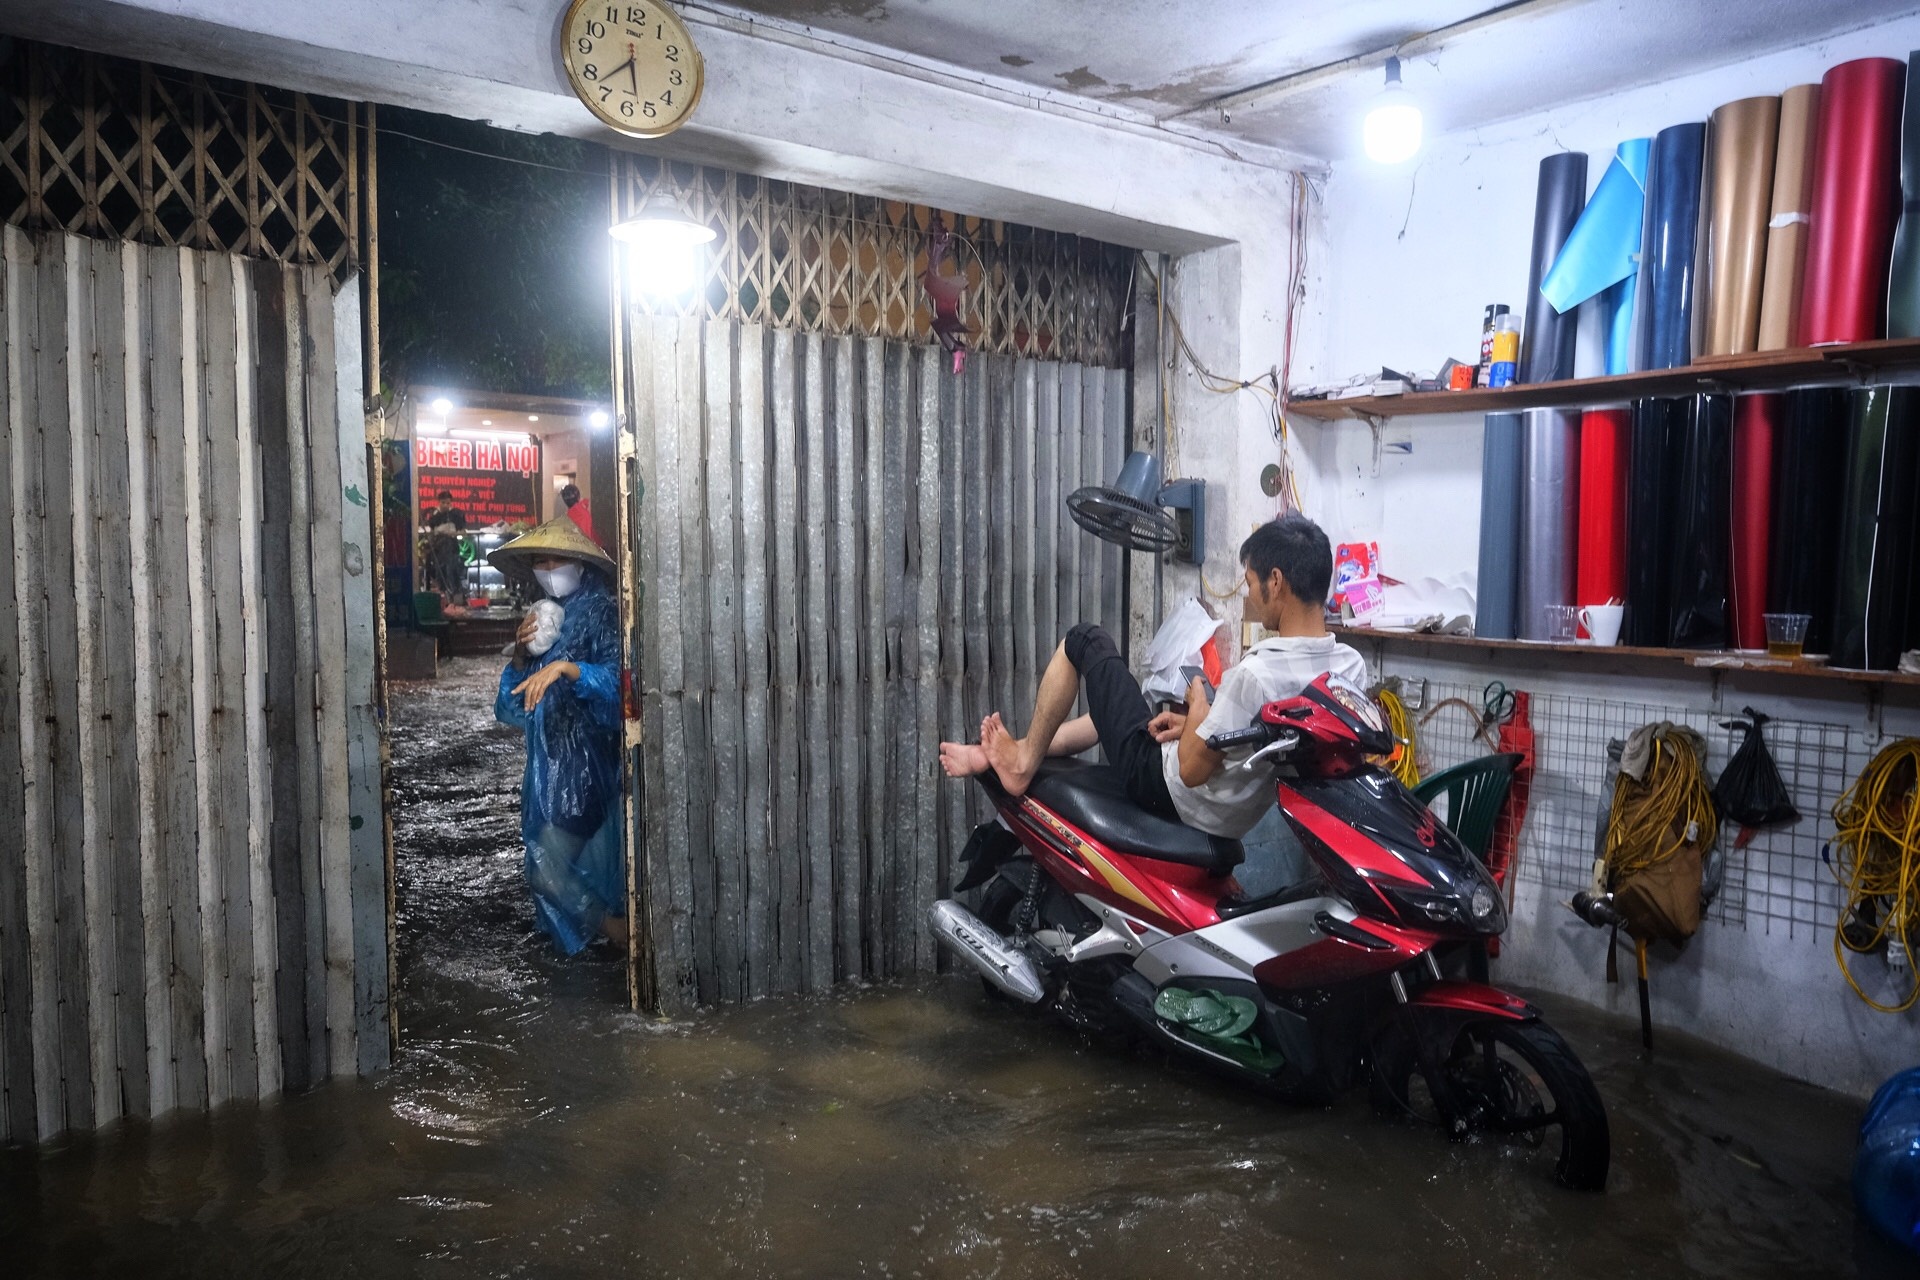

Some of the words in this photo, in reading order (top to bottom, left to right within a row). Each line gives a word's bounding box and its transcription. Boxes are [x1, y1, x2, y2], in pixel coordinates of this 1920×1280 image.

[606, 6, 618, 24] 11
[626, 6, 646, 27] 12
[585, 19, 605, 39] 10
[656, 24, 662, 40] 1
[578, 38, 593, 54] 9
[665, 45, 679, 62] 2
[583, 63, 598, 81] 8
[669, 69, 683, 86] 3
[598, 85, 613, 102] 7
[660, 89, 674, 106] 4
[620, 101, 634, 117] 6
[643, 101, 657, 118] 5
[506, 440, 539, 478] NỘI
